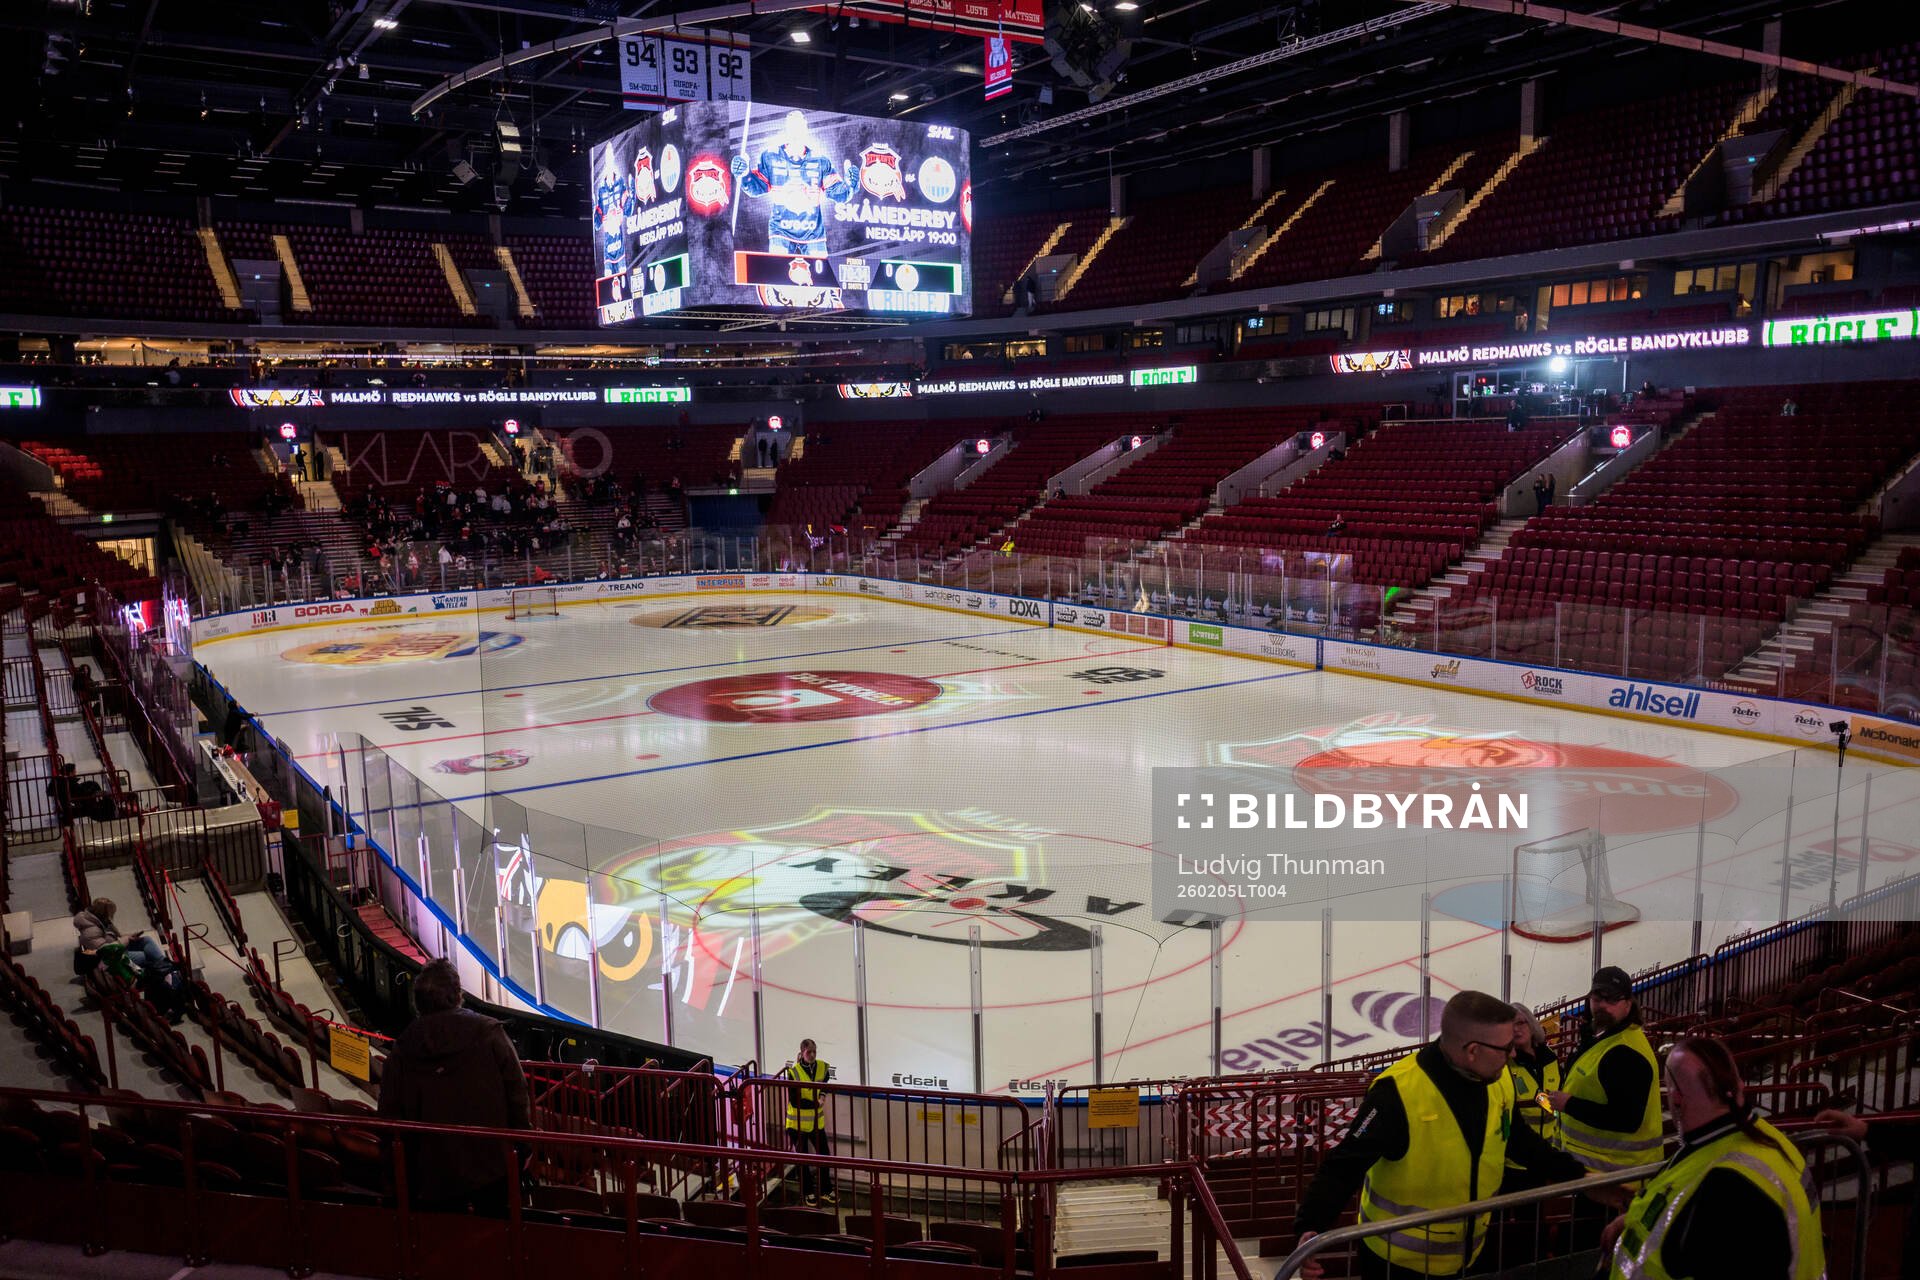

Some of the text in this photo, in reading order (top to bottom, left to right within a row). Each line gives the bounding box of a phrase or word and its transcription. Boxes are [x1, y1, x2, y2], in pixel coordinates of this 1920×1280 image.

[965, 4, 988, 16] LUSTH
[1004, 10, 1041, 23] MATTSSON
[626, 41, 657, 69] 94
[672, 47, 699, 75] 93
[718, 53, 743, 80] 92
[834, 198, 957, 230] SKÅNEDERBY
[865, 226, 957, 245] NEDSLÄPP 19:00
[1419, 328, 1749, 364] MALMÖ REDHAWKS vs RÖGLE BANDYKLUBB
[918, 374, 1125, 394] MALMÖ REDHAWKS vs RÖGLE BANDYKLUBB
[331, 390, 597, 403] MALMÖ REDHAWKS vs RÖGLE BANDYKLUBB
[608, 583, 645, 592] TREANO
[294, 603, 356, 618] BORGA
[1009, 599, 1041, 619] DOXA
[1535, 675, 1563, 689] ROCK
[1608, 682, 1701, 719] ahlsell
[1732, 706, 1761, 719] Retro
[1794, 714, 1825, 729] Retro
